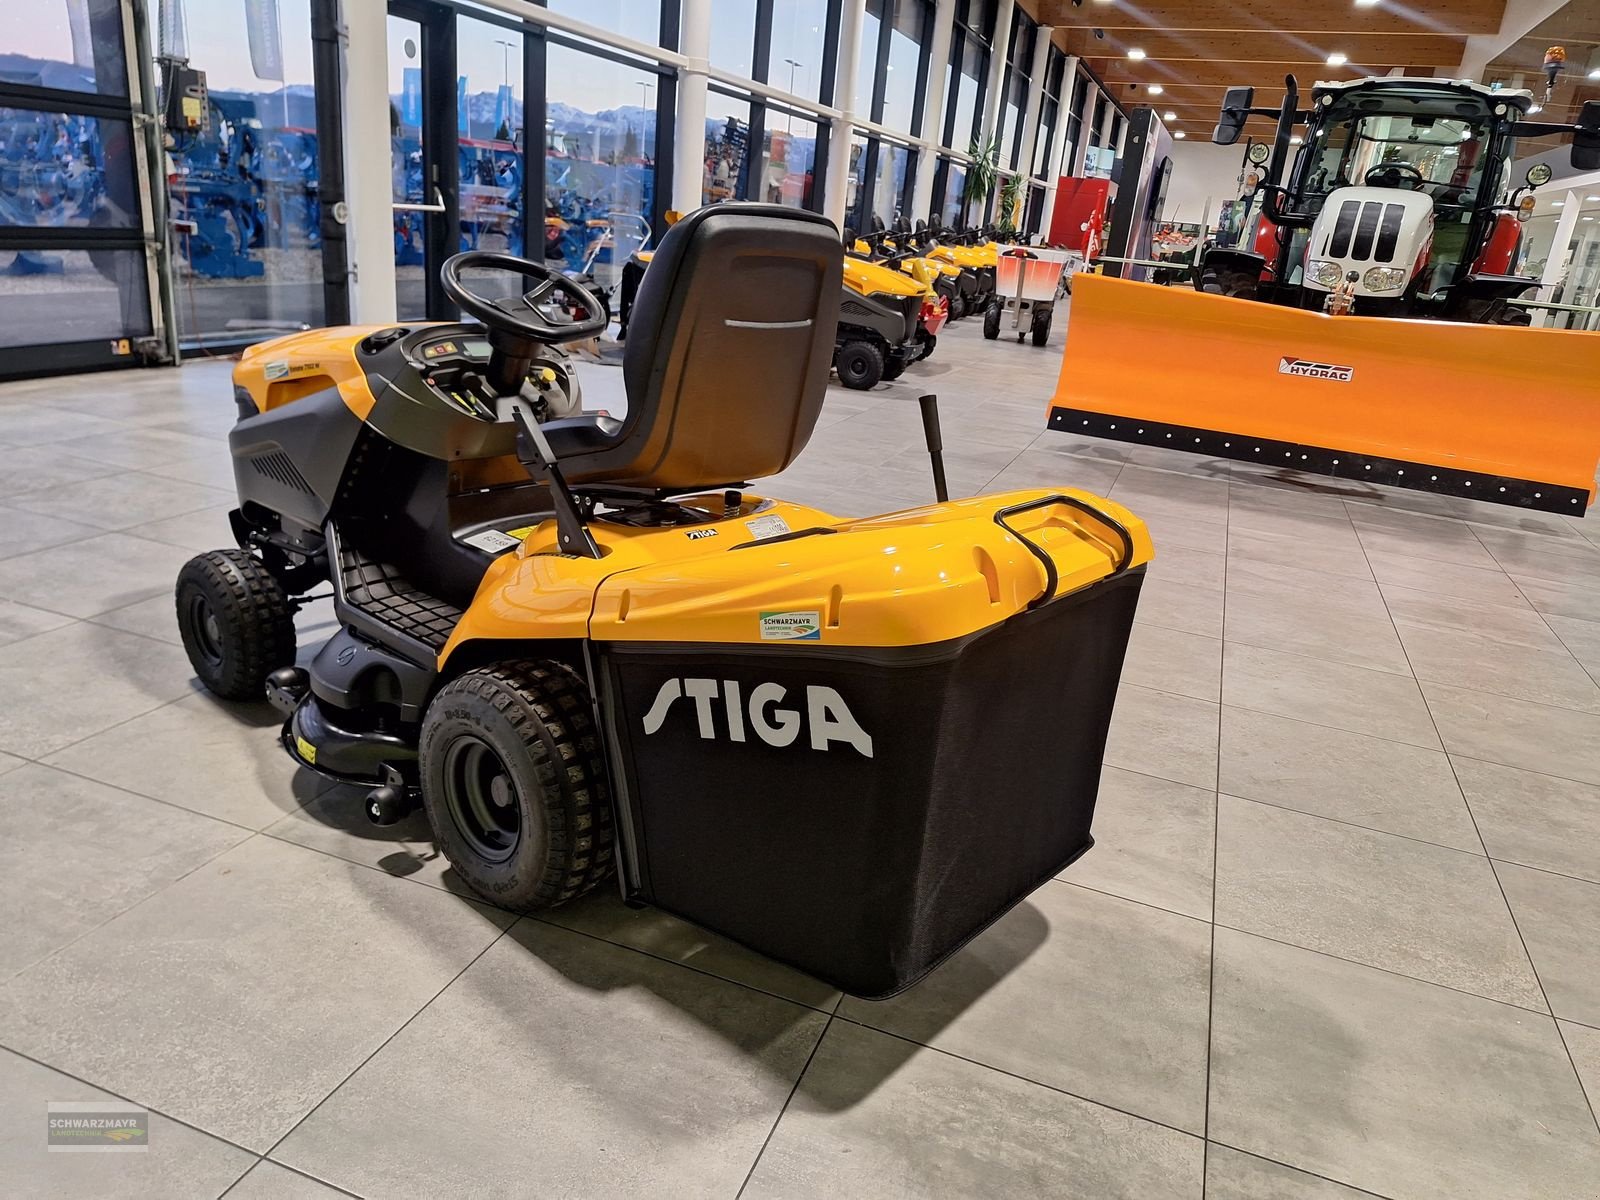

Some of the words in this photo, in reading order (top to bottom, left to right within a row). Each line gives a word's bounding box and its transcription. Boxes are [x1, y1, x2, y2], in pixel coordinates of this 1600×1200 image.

[1290, 366, 1349, 380] HYDRAC
[688, 529, 719, 539] STIGA
[642, 678, 874, 758] STIGA
